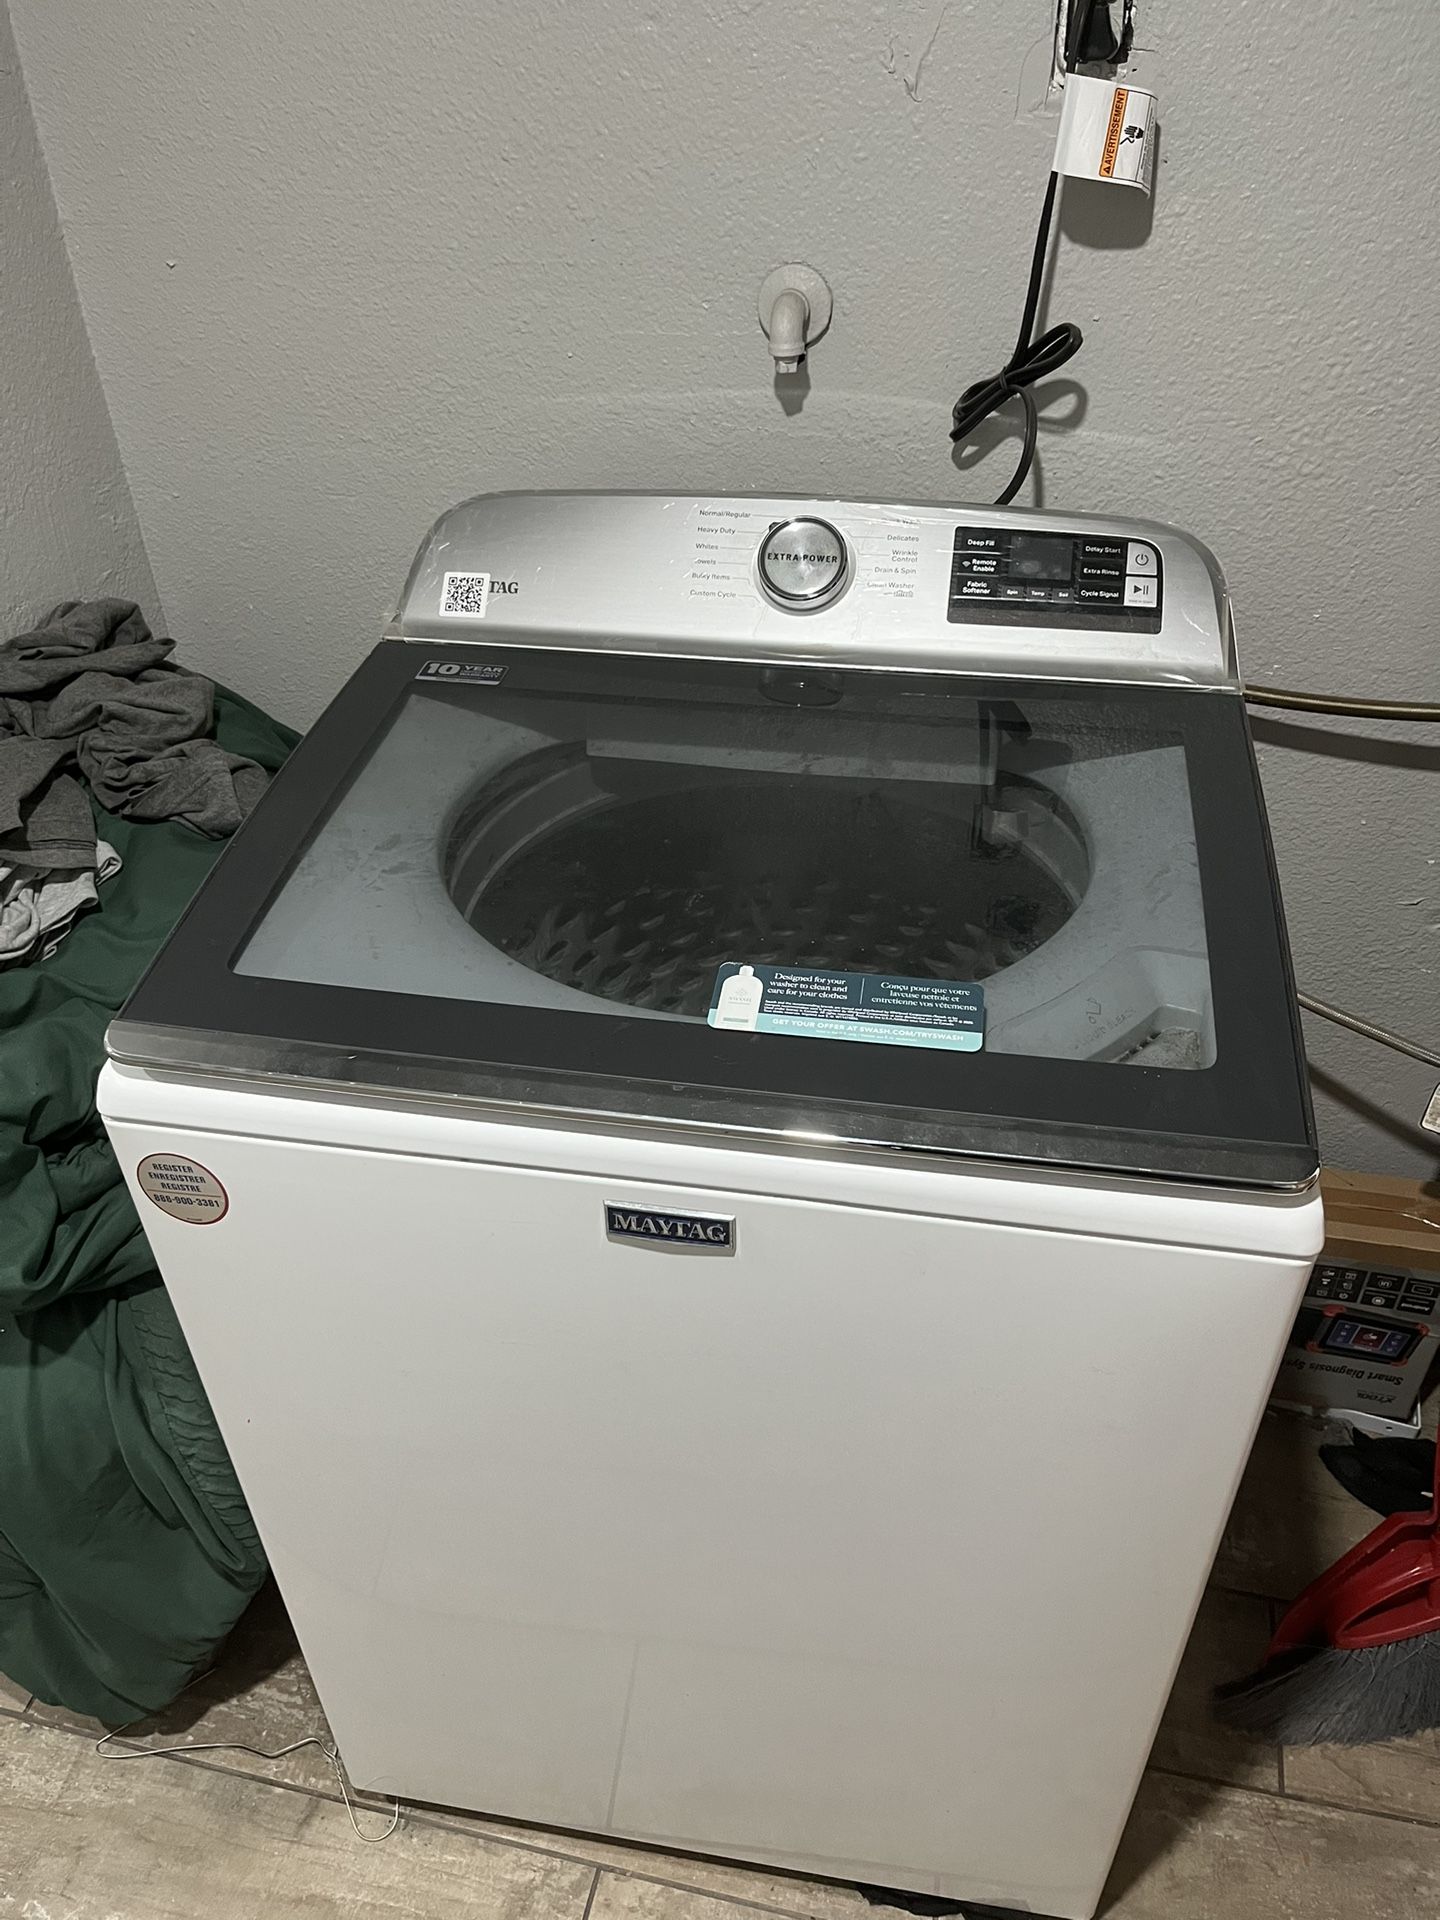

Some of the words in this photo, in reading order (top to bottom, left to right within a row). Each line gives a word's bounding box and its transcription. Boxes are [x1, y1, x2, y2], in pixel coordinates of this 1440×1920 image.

[1105, 91, 1125, 165] AVERTISSEMENT
[699, 510, 751, 518] Normal/Regular
[697, 526, 718, 534] Heavy
[720, 527, 736, 535] Duty
[887, 534, 920, 542] Delicates
[767, 552, 799, 561] EXTRA
[802, 554, 838, 563] POWER
[972, 558, 997, 566] Remote
[962, 586, 991, 594] Softener
[1100, 590, 1120, 598] Signal
[427, 663, 460, 675] 10
[465, 665, 504, 673] YEAR
[774, 972, 813, 983] Designed
[769, 980, 799, 988] washer
[880, 981, 909, 991] Conçu
[932, 988, 948, 996] que
[948, 988, 971, 996] votre
[818, 991, 848, 1000] clothes
[890, 990, 920, 999] laveuse
[921, 994, 950, 1002] nettoie
[871, 997, 918, 1007] entretienne
[935, 1001, 978, 1011] vêtements
[817, 1022, 845, 1030] OFFER
[860, 1027, 964, 1041] SWASH.COM/TRYSWASH
[152, 1163, 194, 1174] REGISTER
[148, 1172, 206, 1184] ENREGISTRER
[160, 1182, 202, 1192] REGISTRE
[612, 1212, 727, 1242] MAYTAG
[1309, 1363, 1365, 1379] Diagnosis
[1367, 1371, 1404, 1386] Smart
